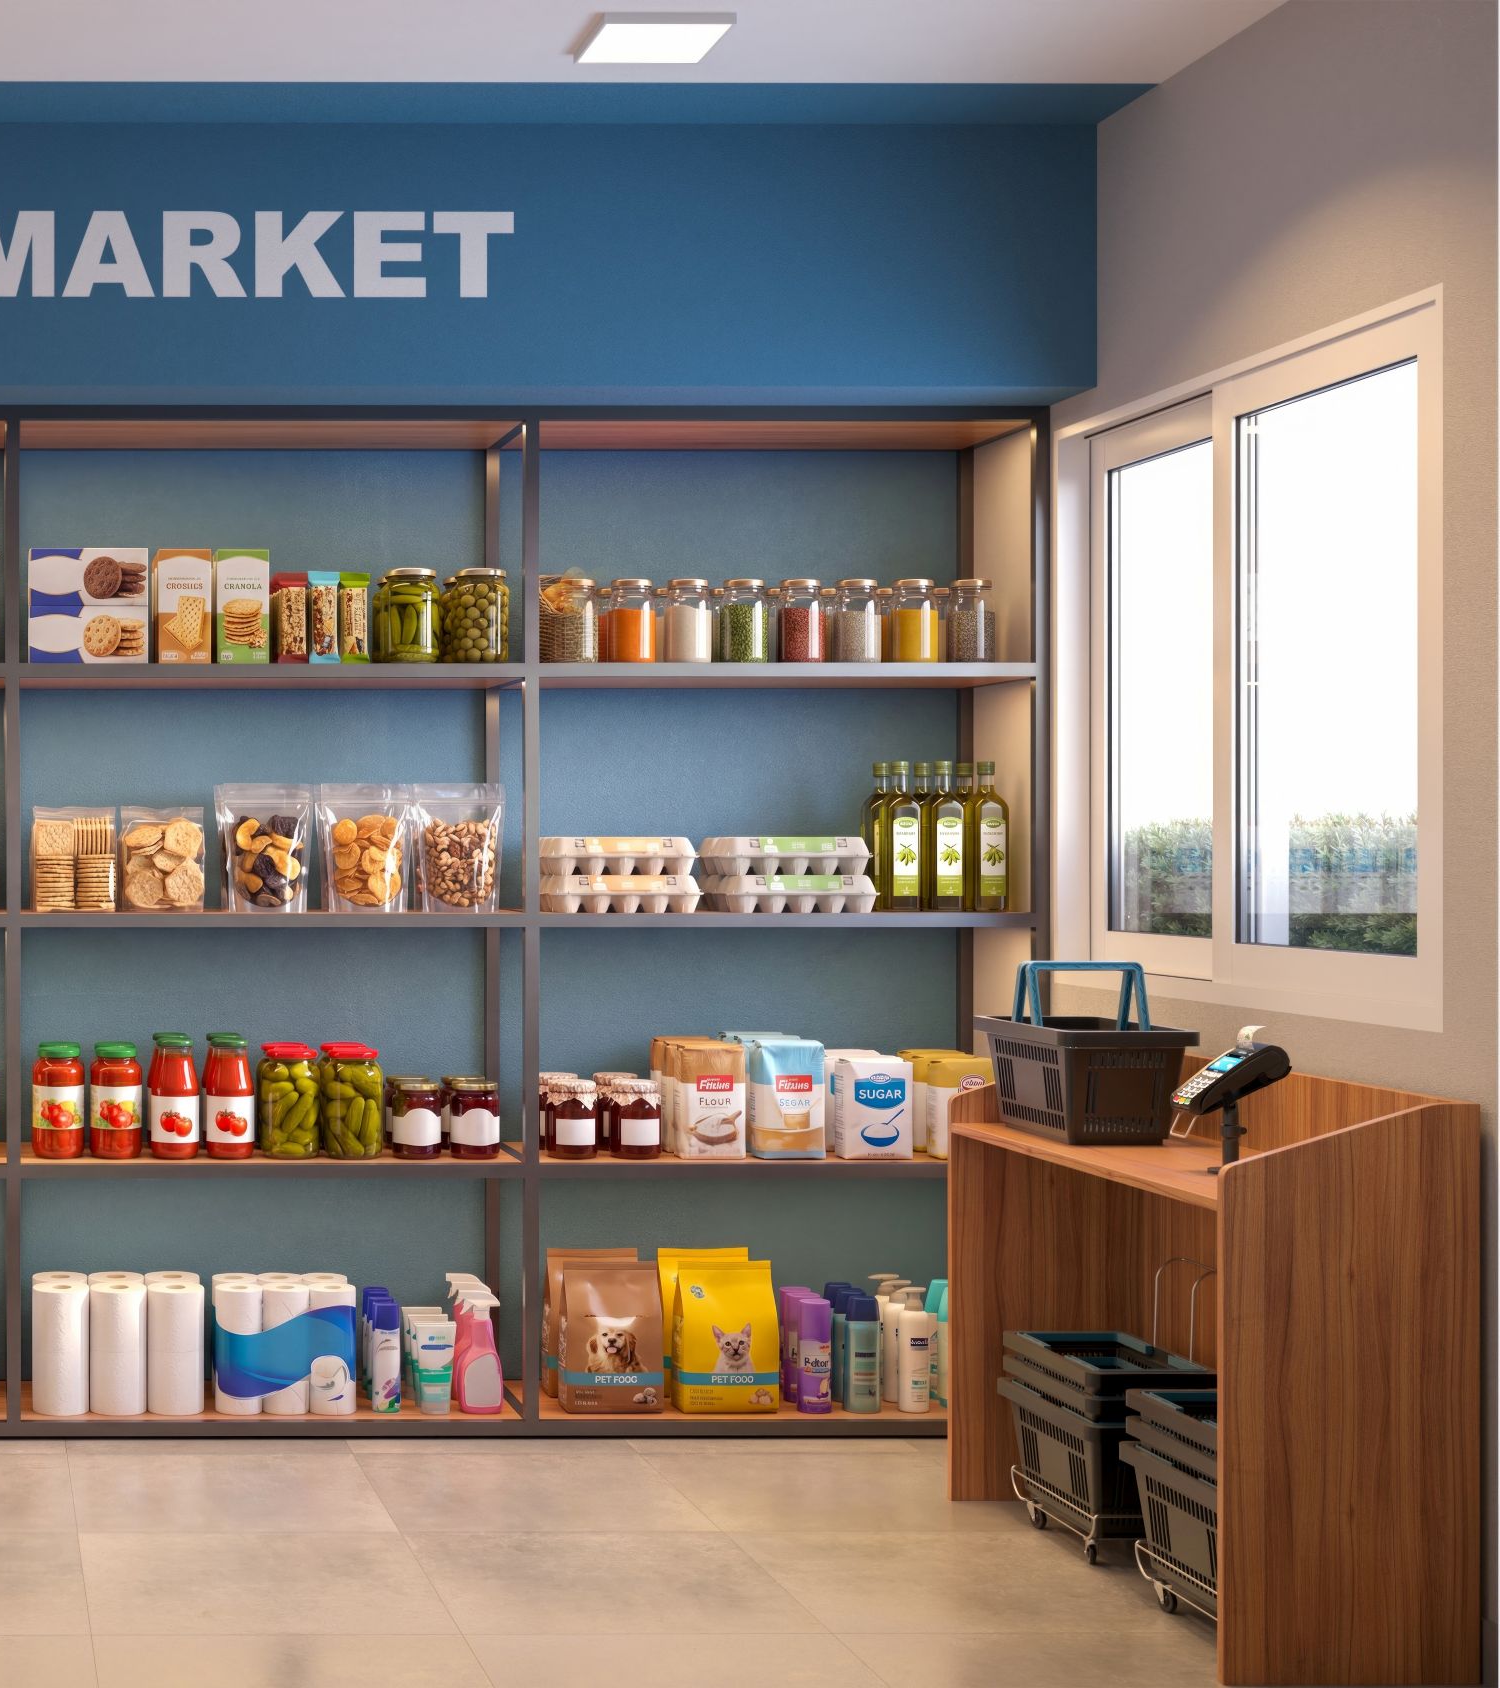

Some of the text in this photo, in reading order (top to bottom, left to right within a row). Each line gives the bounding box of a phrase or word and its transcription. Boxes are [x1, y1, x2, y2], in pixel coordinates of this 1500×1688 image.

[858, 1089, 902, 1100] SUGAR
[699, 1097, 731, 1106] FLOUR
[595, 1375, 613, 1384] PET
[711, 1375, 729, 1384] PET
